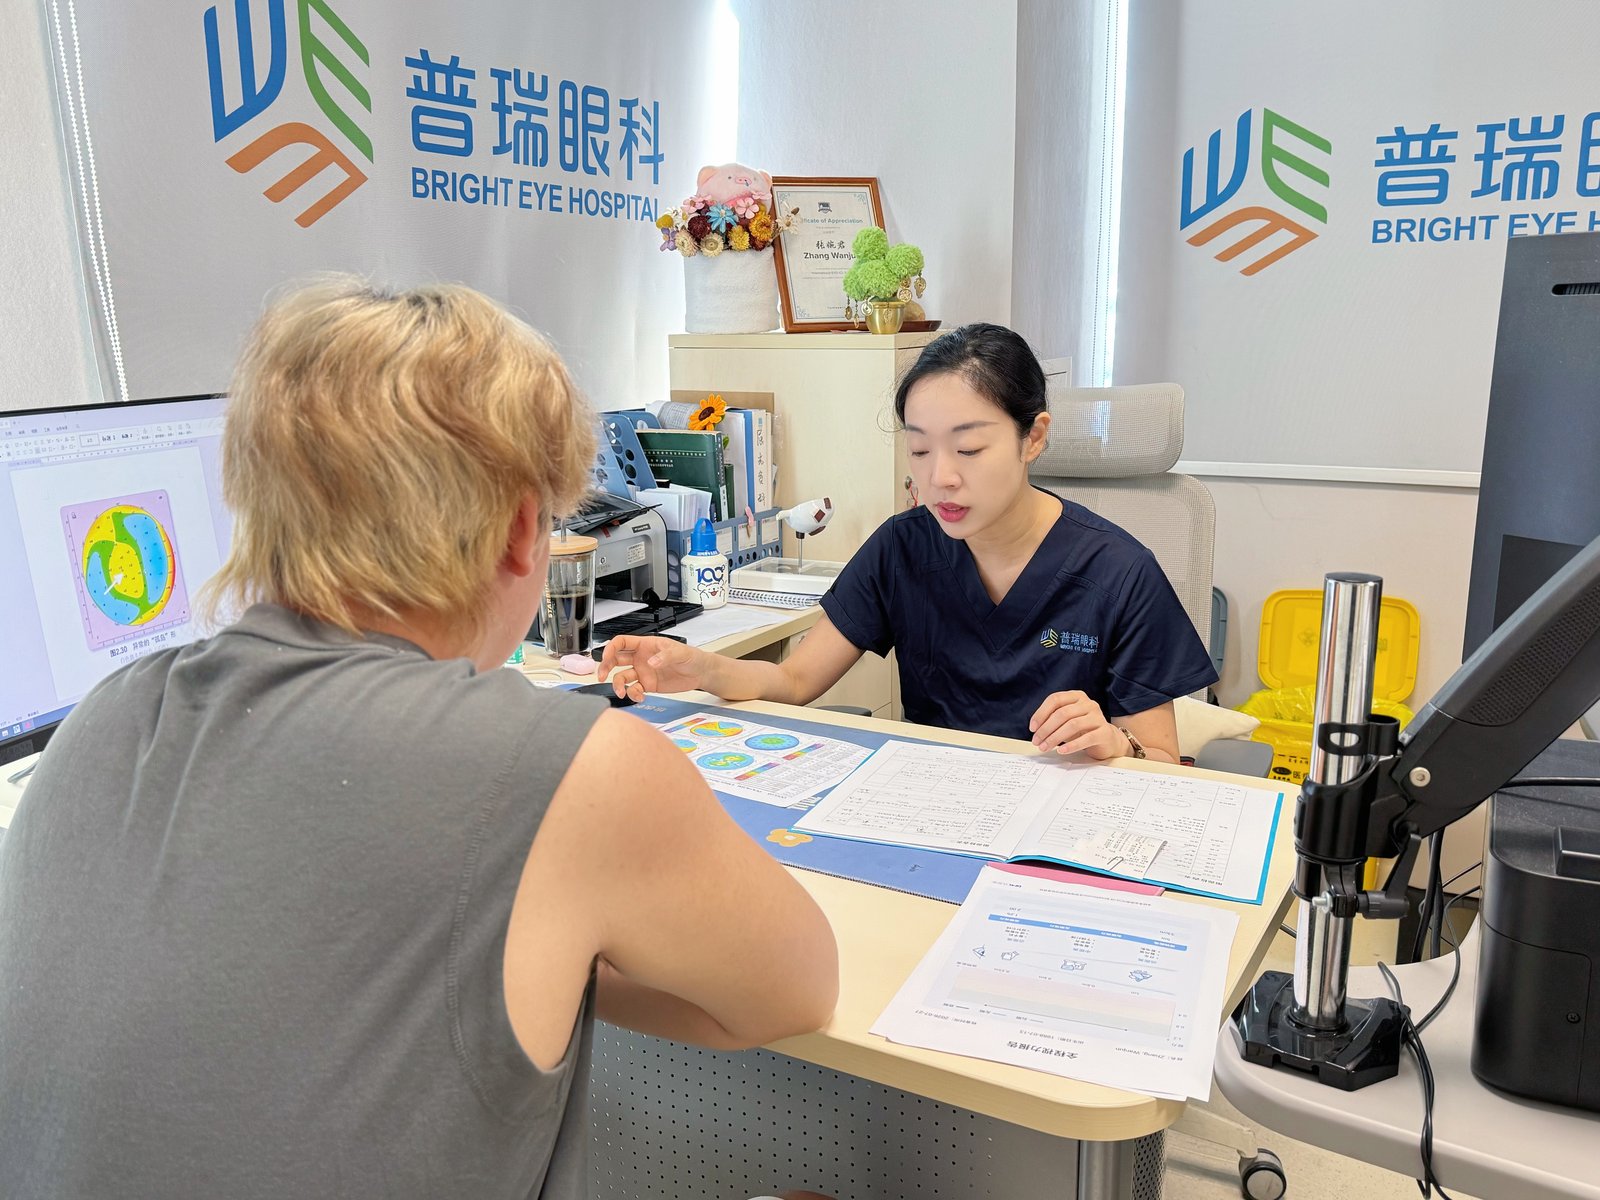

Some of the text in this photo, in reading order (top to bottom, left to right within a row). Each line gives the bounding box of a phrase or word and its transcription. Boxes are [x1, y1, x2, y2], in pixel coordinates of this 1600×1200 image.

[405, 48, 664, 185] 普瑞眼科
[411, 167, 513, 207] BRIGHT
[518, 180, 563, 213] EYE
[1371, 215, 1499, 243] BRIGHT
[1508, 211, 1578, 238] EYE
[803, 252, 856, 261] Zhang Wanju
